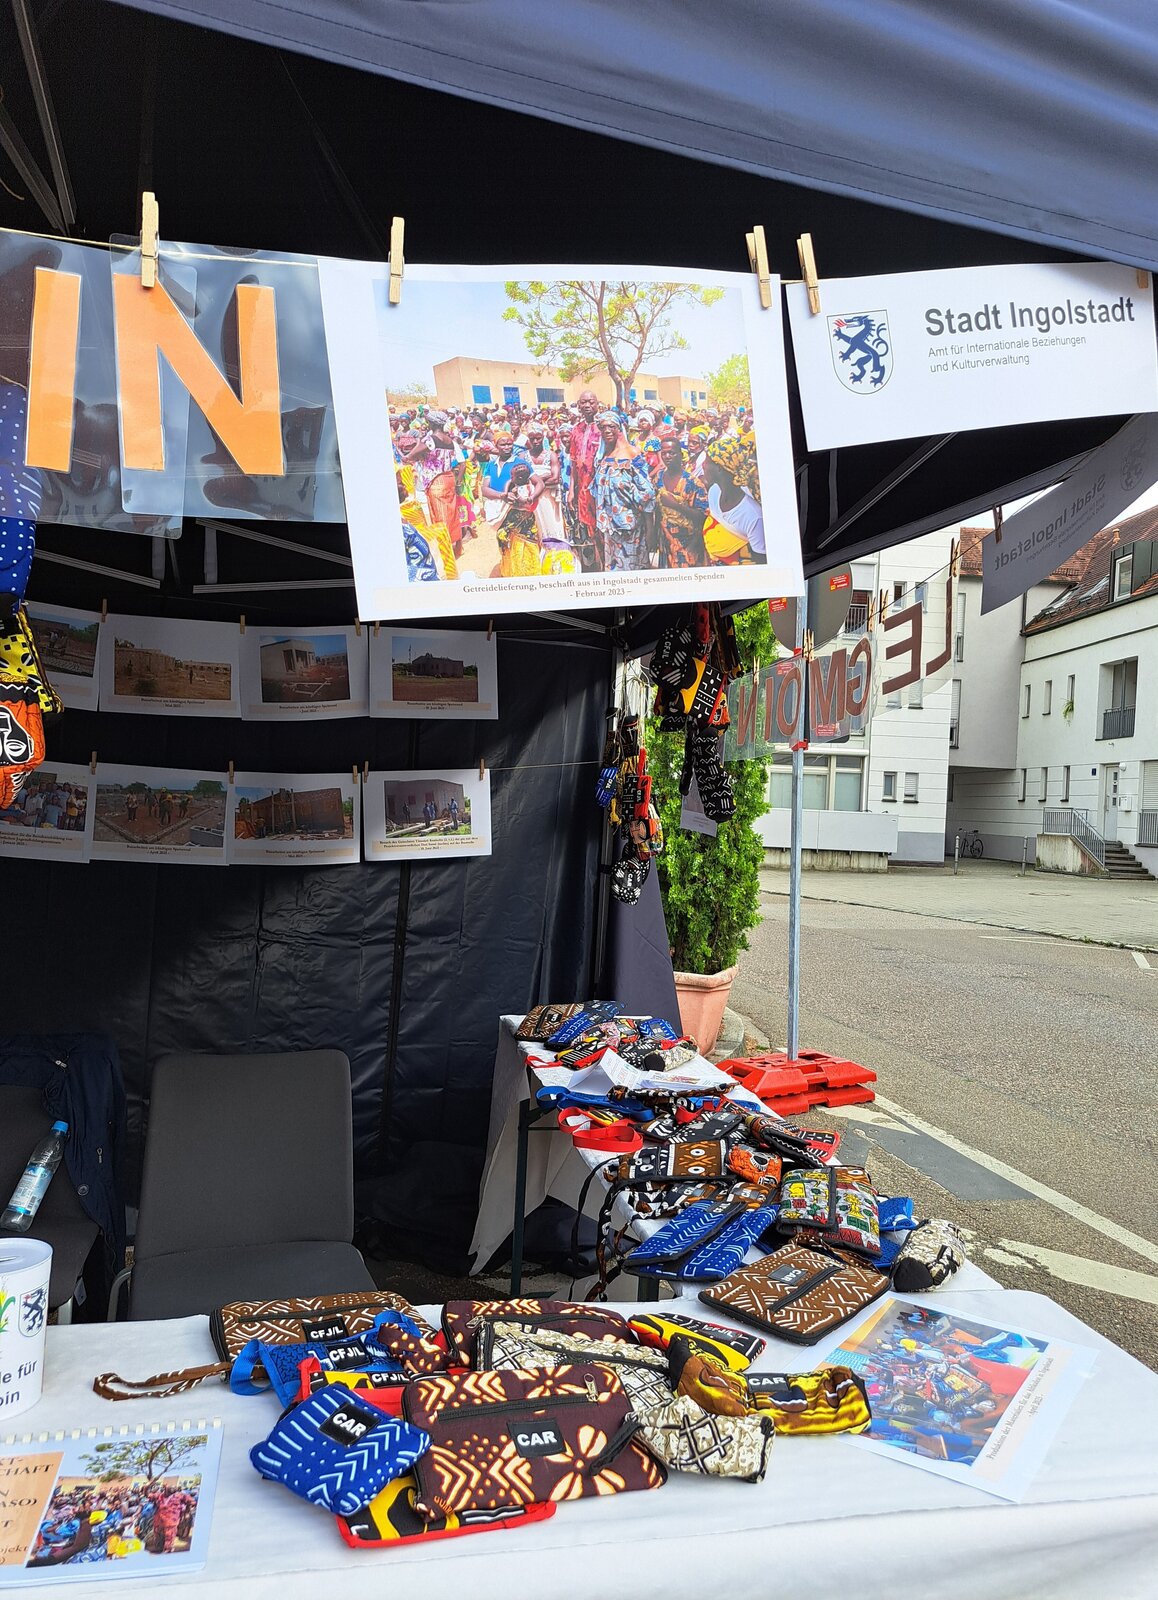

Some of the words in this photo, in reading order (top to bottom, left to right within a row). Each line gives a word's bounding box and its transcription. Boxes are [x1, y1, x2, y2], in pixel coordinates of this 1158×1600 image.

[924, 303, 1002, 337] Stadt
[1009, 296, 1136, 334] Ingolstadt
[928, 346, 949, 358] Amt
[950, 344, 965, 356] für
[966, 338, 1030, 355] Internationale
[1031, 335, 1087, 349] Beziehungen
[930, 360, 949, 373] und
[951, 353, 1030, 371] Kulturverwaltung
[462, 582, 537, 594] Getreidelieferung,
[538, 580, 576, 590] beschafft
[577, 579, 591, 587] aus
[592, 578, 601, 586] in
[603, 576, 642, 588] Ingolstadt
[643, 574, 693, 586] gesammelten
[694, 572, 725, 584] Spenden
[575, 589, 607, 599] Februar
[607, 588, 626, 597] 2023
[780, 1269, 802, 1282] CAR
[309, 1325, 344, 1340] CFJ/L
[328, 1344, 365, 1363] CFJ/L
[18, 1360, 38, 1379] für
[371, 1371, 409, 1384] CFJ/L
[747, 1376, 786, 1387] CAR
[331, 1412, 367, 1436] CAR
[516, 1429, 558, 1447] CAR
